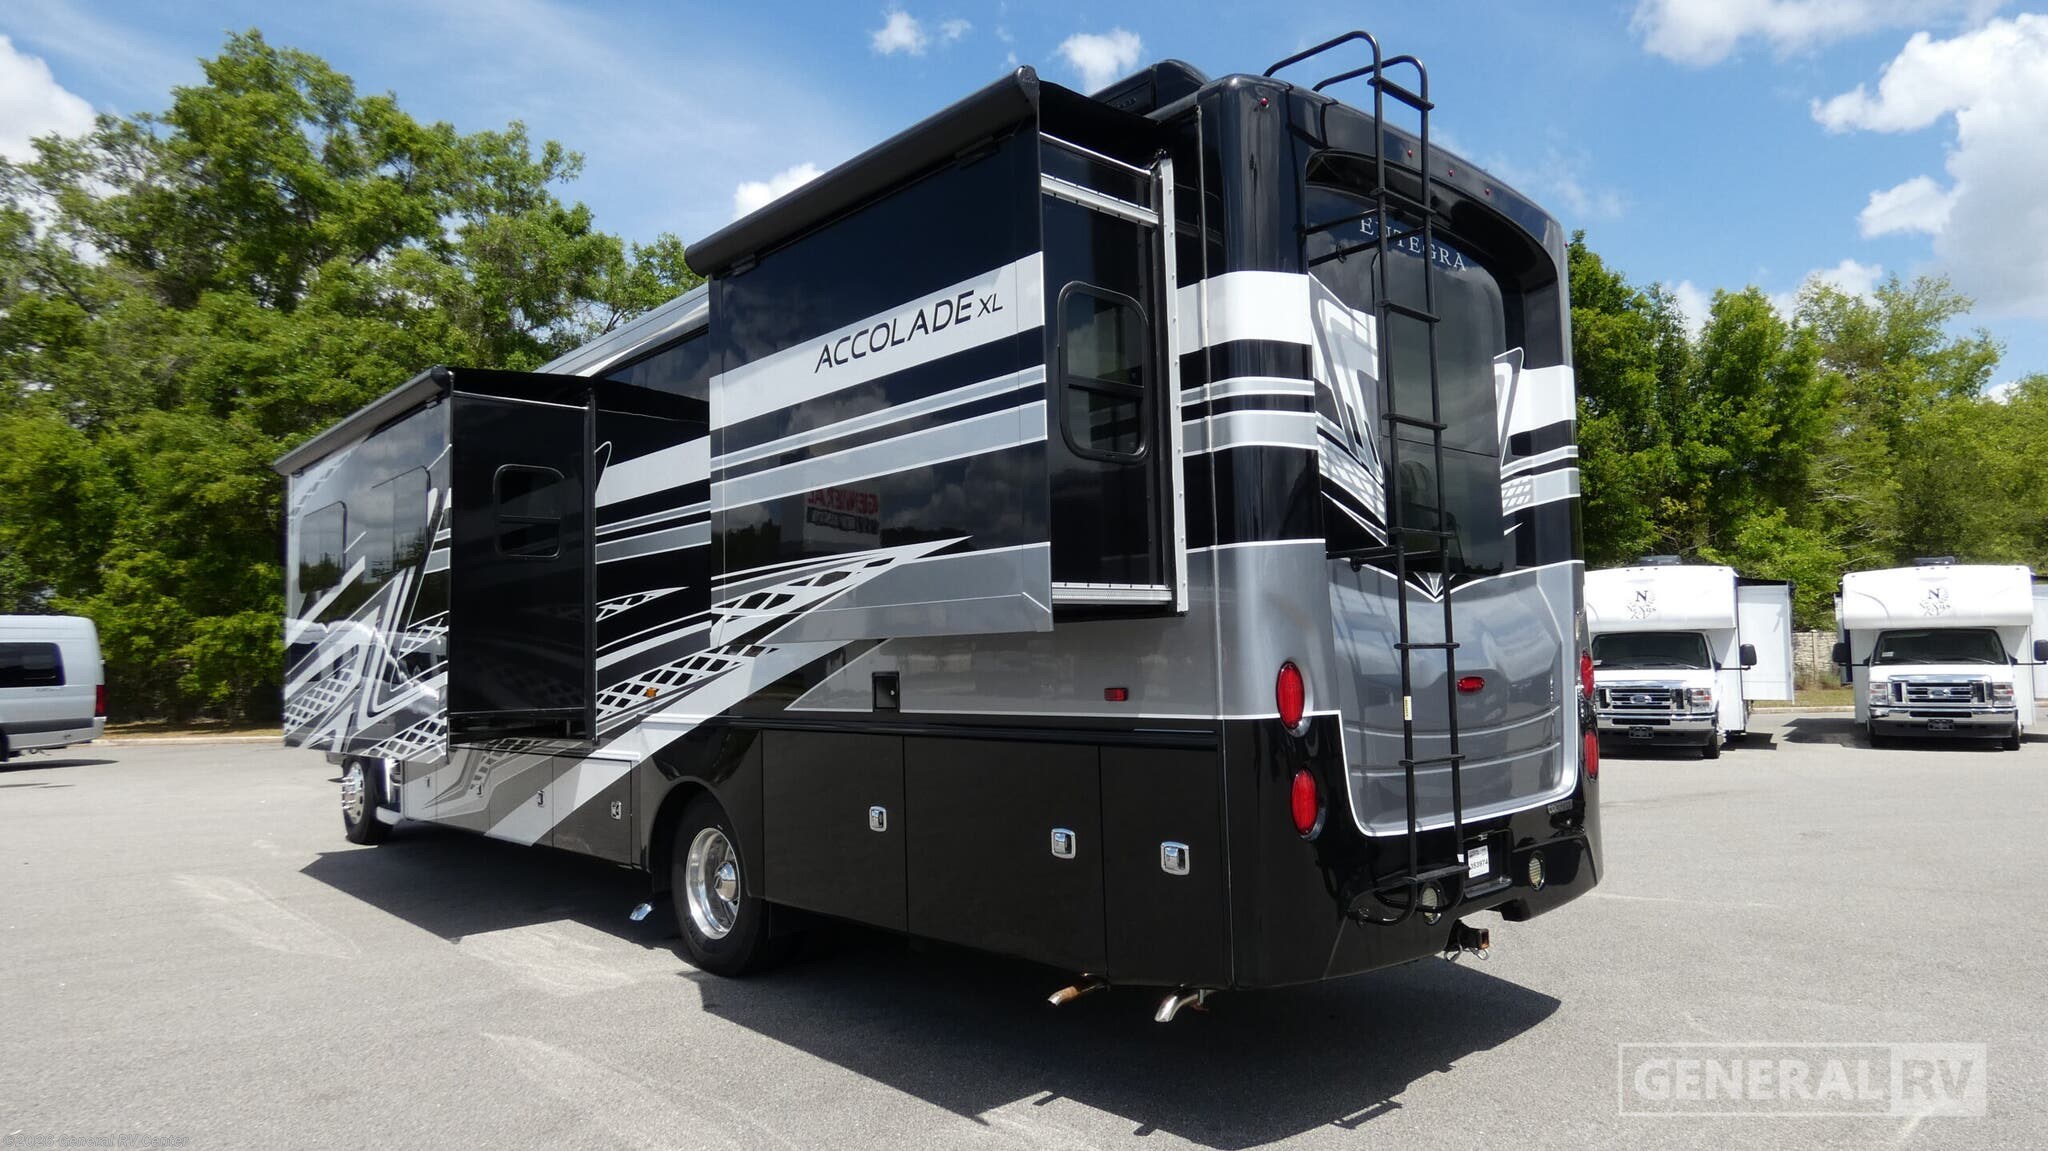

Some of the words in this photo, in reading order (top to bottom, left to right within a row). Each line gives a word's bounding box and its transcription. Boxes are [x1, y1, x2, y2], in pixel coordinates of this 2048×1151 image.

[814, 289, 975, 374] ACCOLADE
[977, 293, 1004, 318] XL
[1635, 590, 1649, 602] N
